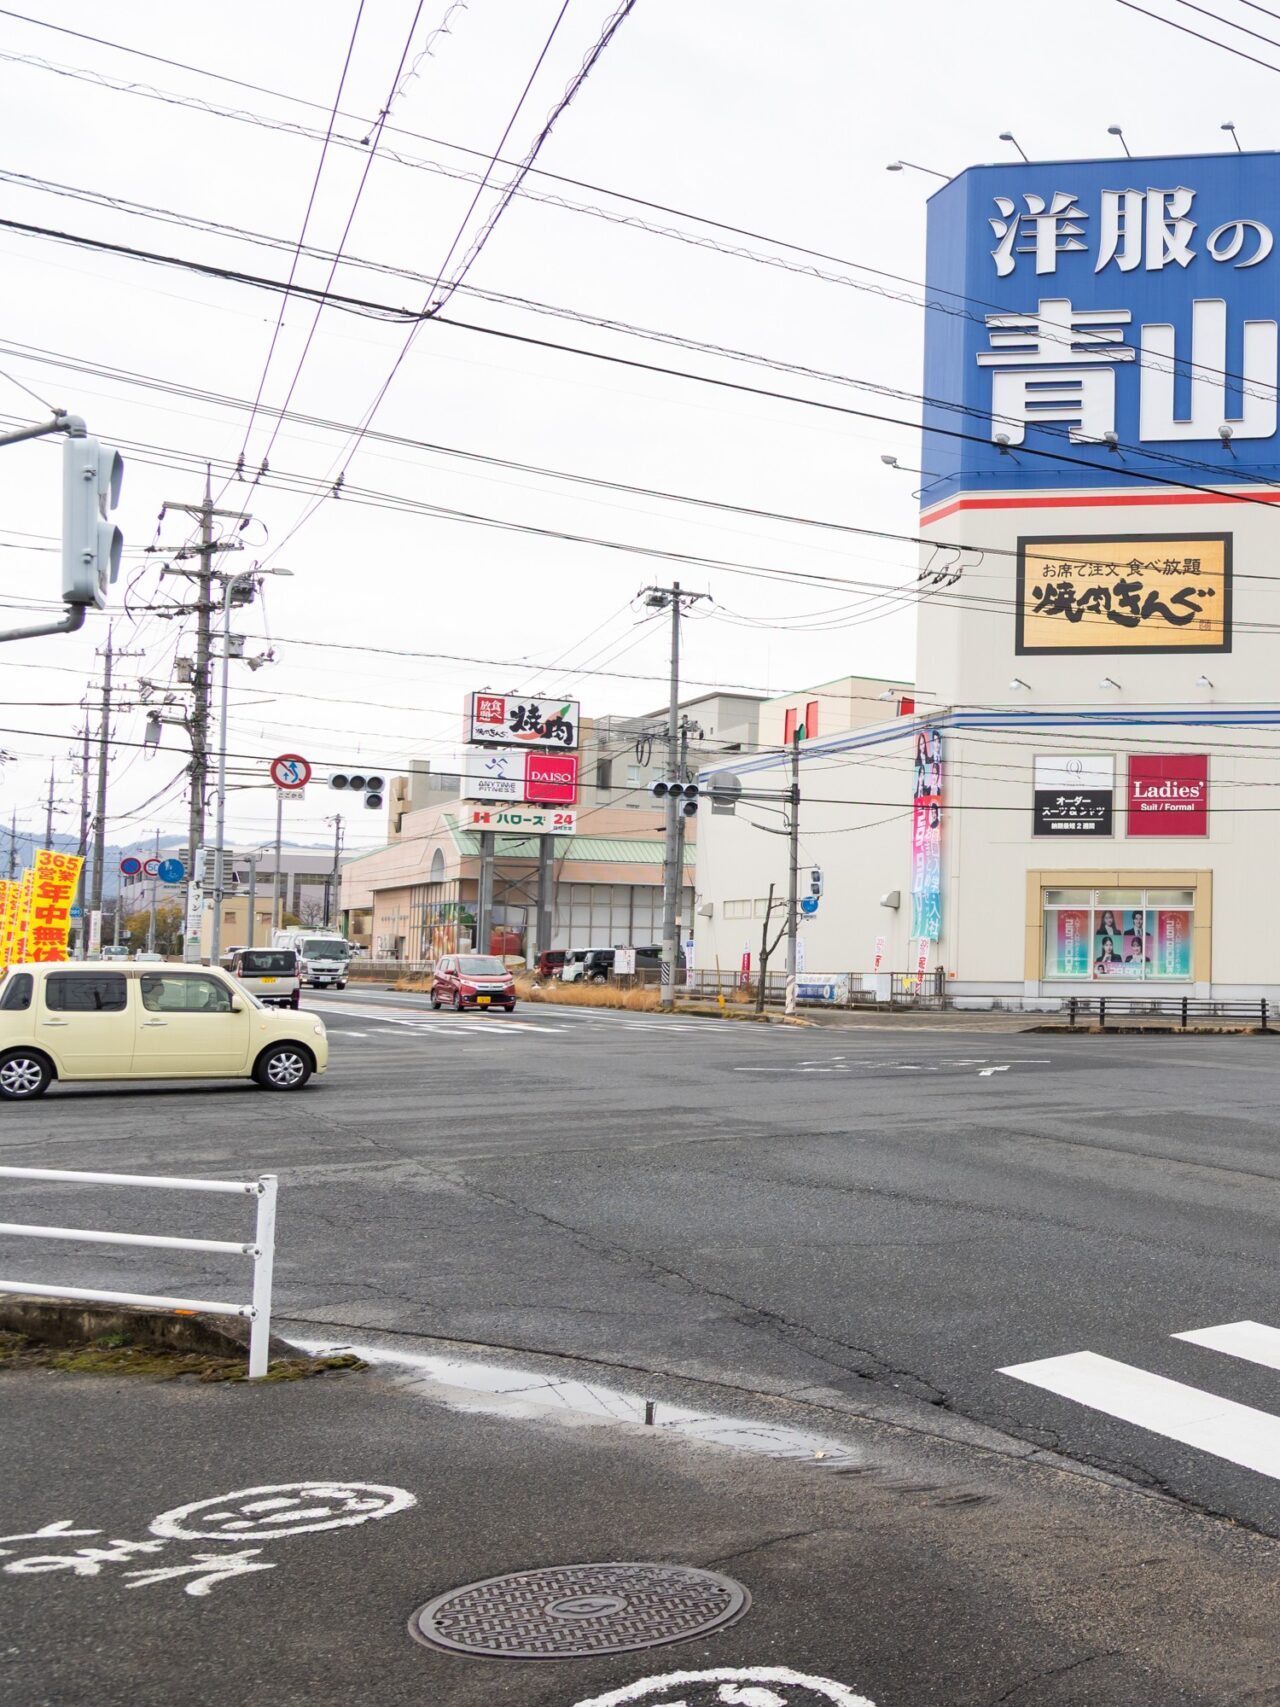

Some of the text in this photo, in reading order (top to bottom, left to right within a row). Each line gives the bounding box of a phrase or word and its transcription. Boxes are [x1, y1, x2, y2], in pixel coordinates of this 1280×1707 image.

[989, 186, 1274, 277] 洋服の
[976, 298, 1278, 445] 青山
[1126, 558, 1201, 576] 食べ放題
[1032, 577, 1216, 628] 焼肉きんぐ
[509, 703, 574, 746] 焼肉
[478, 780, 516, 788] ANYTIME
[531, 771, 571, 782] DAISO
[1056, 796, 1092, 806] オーダー
[1141, 803, 1158, 811] Suit
[1165, 803, 1195, 811] Formal
[553, 813, 573, 825] 24
[39, 852, 79, 871] 365
[38, 867, 76, 882] 営業
[33, 882, 71, 962] 年中無休
